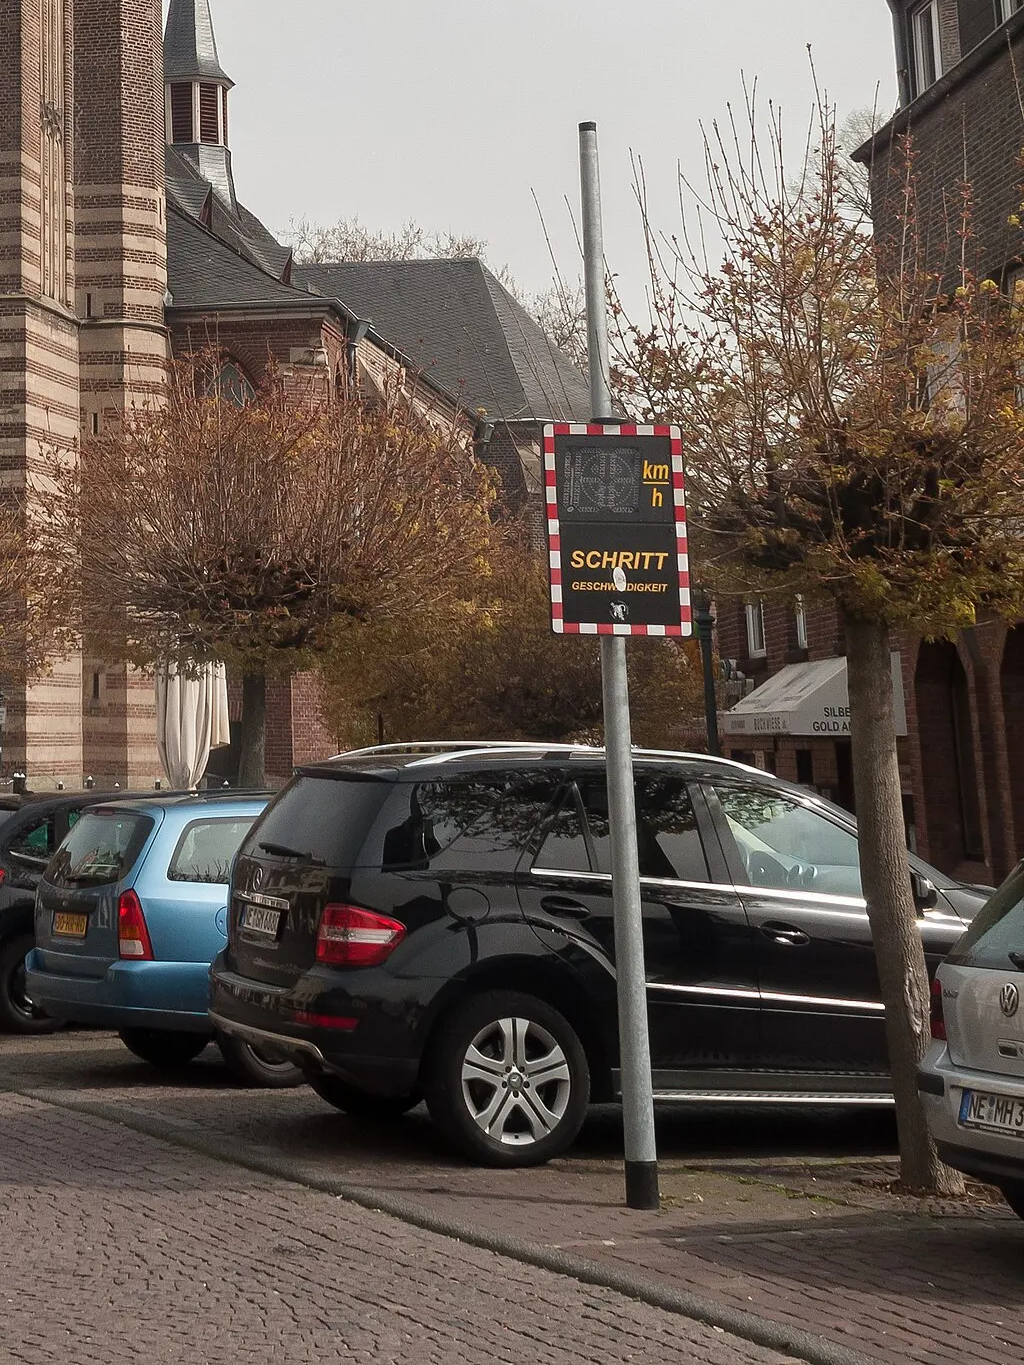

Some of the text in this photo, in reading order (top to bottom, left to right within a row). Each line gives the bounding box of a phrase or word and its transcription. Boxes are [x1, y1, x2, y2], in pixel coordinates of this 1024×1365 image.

[643, 460, 669, 479] km
[651, 488, 663, 507] h
[570, 550, 669, 570] SCHRITT
[572, 581, 668, 592] GESCHWDIGKEIT
[812, 721, 839, 732] GOLD
[968, 1094, 987, 1120] NE
